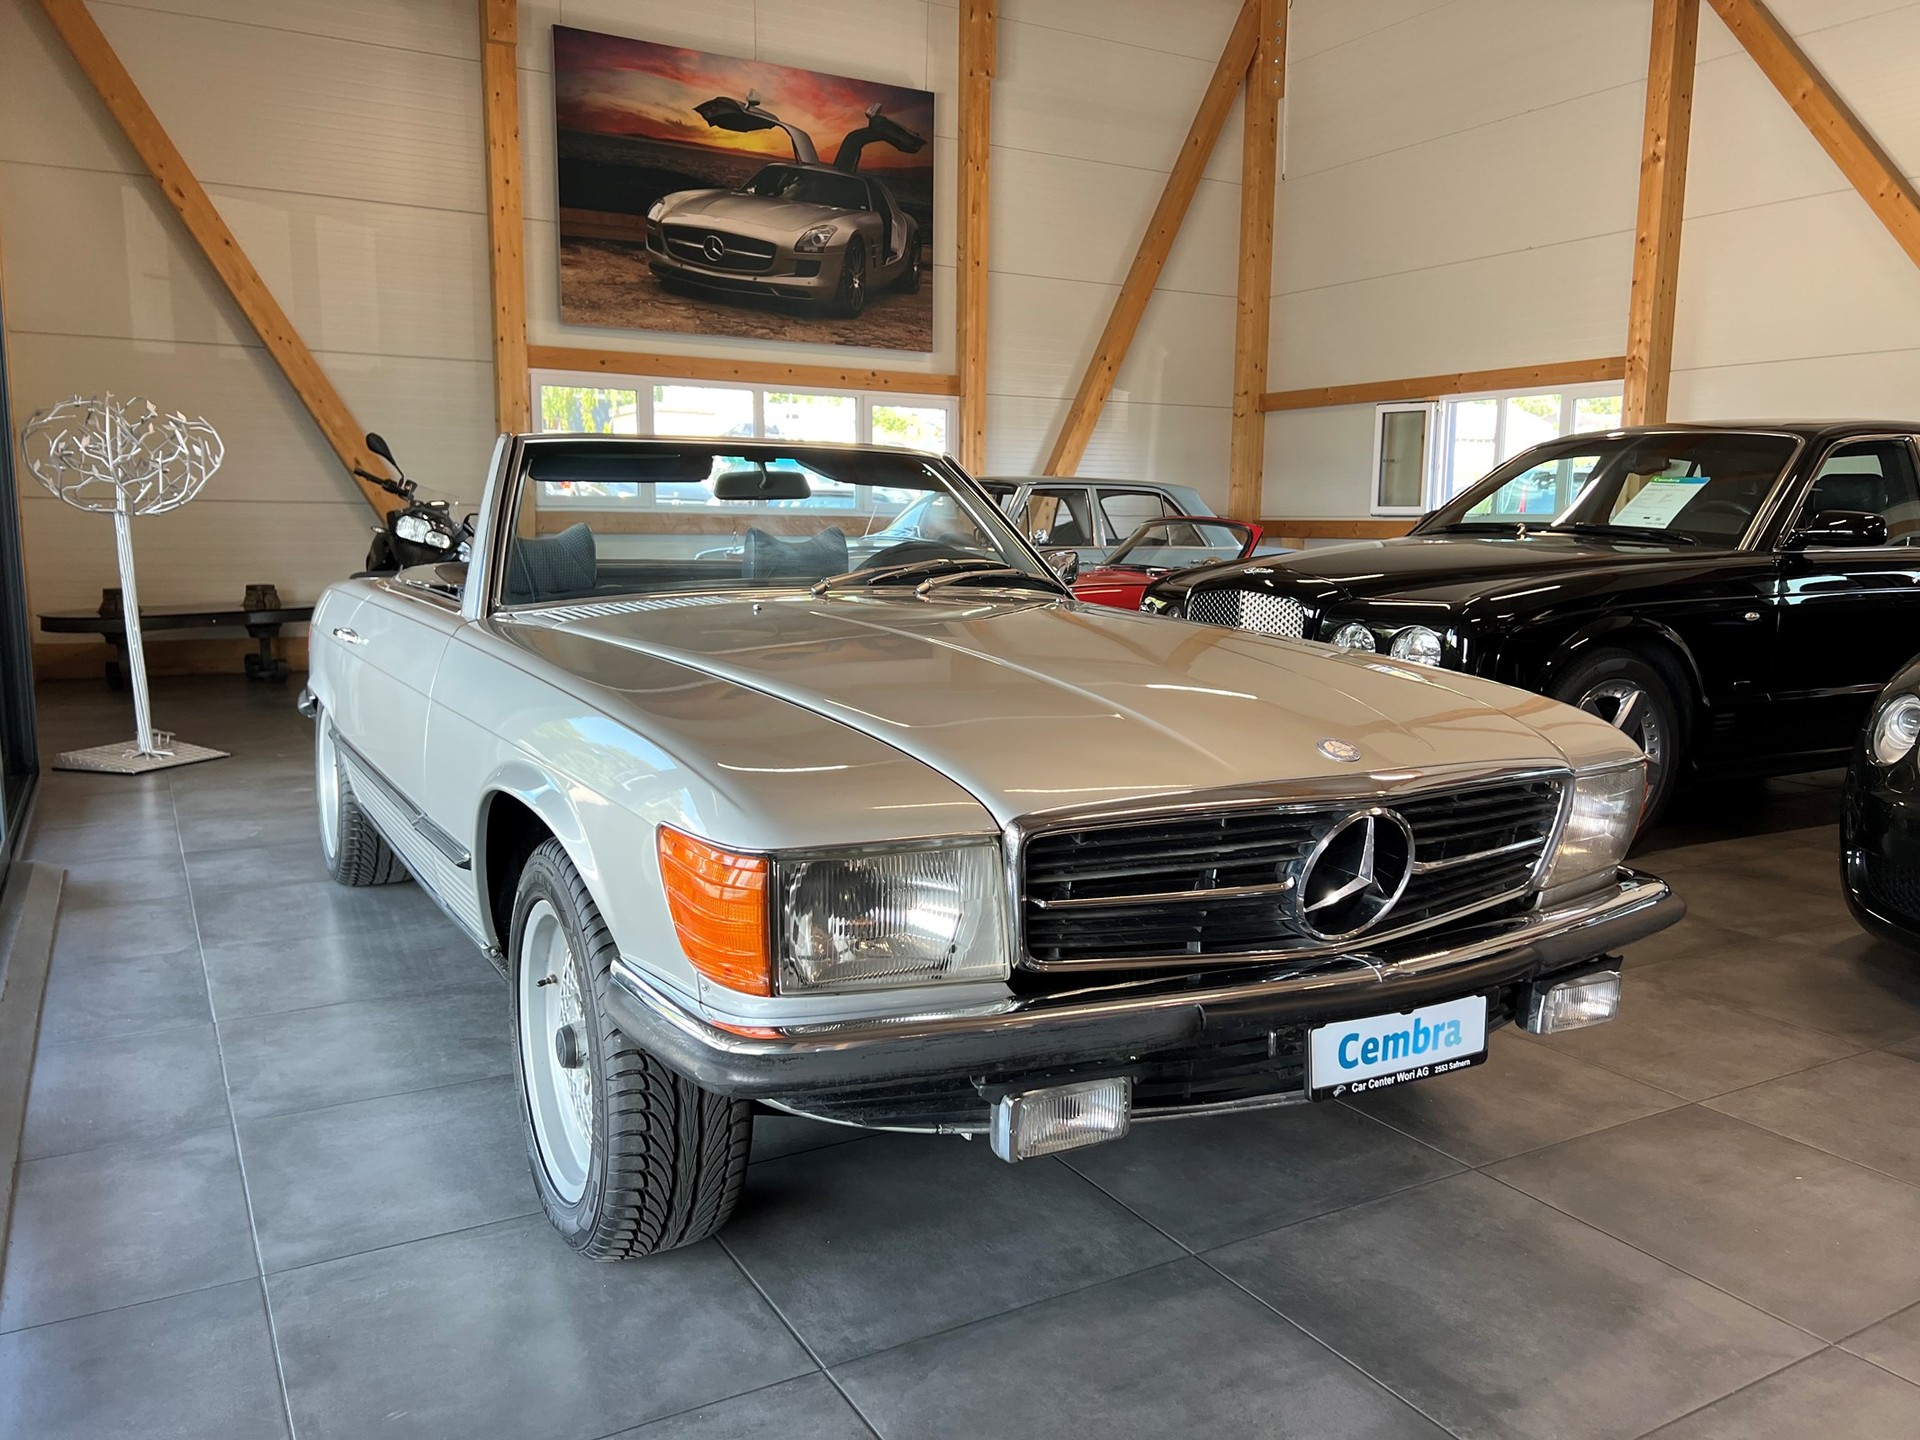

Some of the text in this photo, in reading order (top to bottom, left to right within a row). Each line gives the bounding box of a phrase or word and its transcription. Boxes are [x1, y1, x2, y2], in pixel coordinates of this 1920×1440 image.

[1338, 1017, 1462, 1069] Cembra
[1351, 1082, 1367, 1093] Car
[1368, 1076, 1395, 1089] Center
[1416, 1066, 1429, 1078] AG
[1434, 1065, 1448, 1074] 2553
[1448, 1059, 1470, 1070] Safnern
